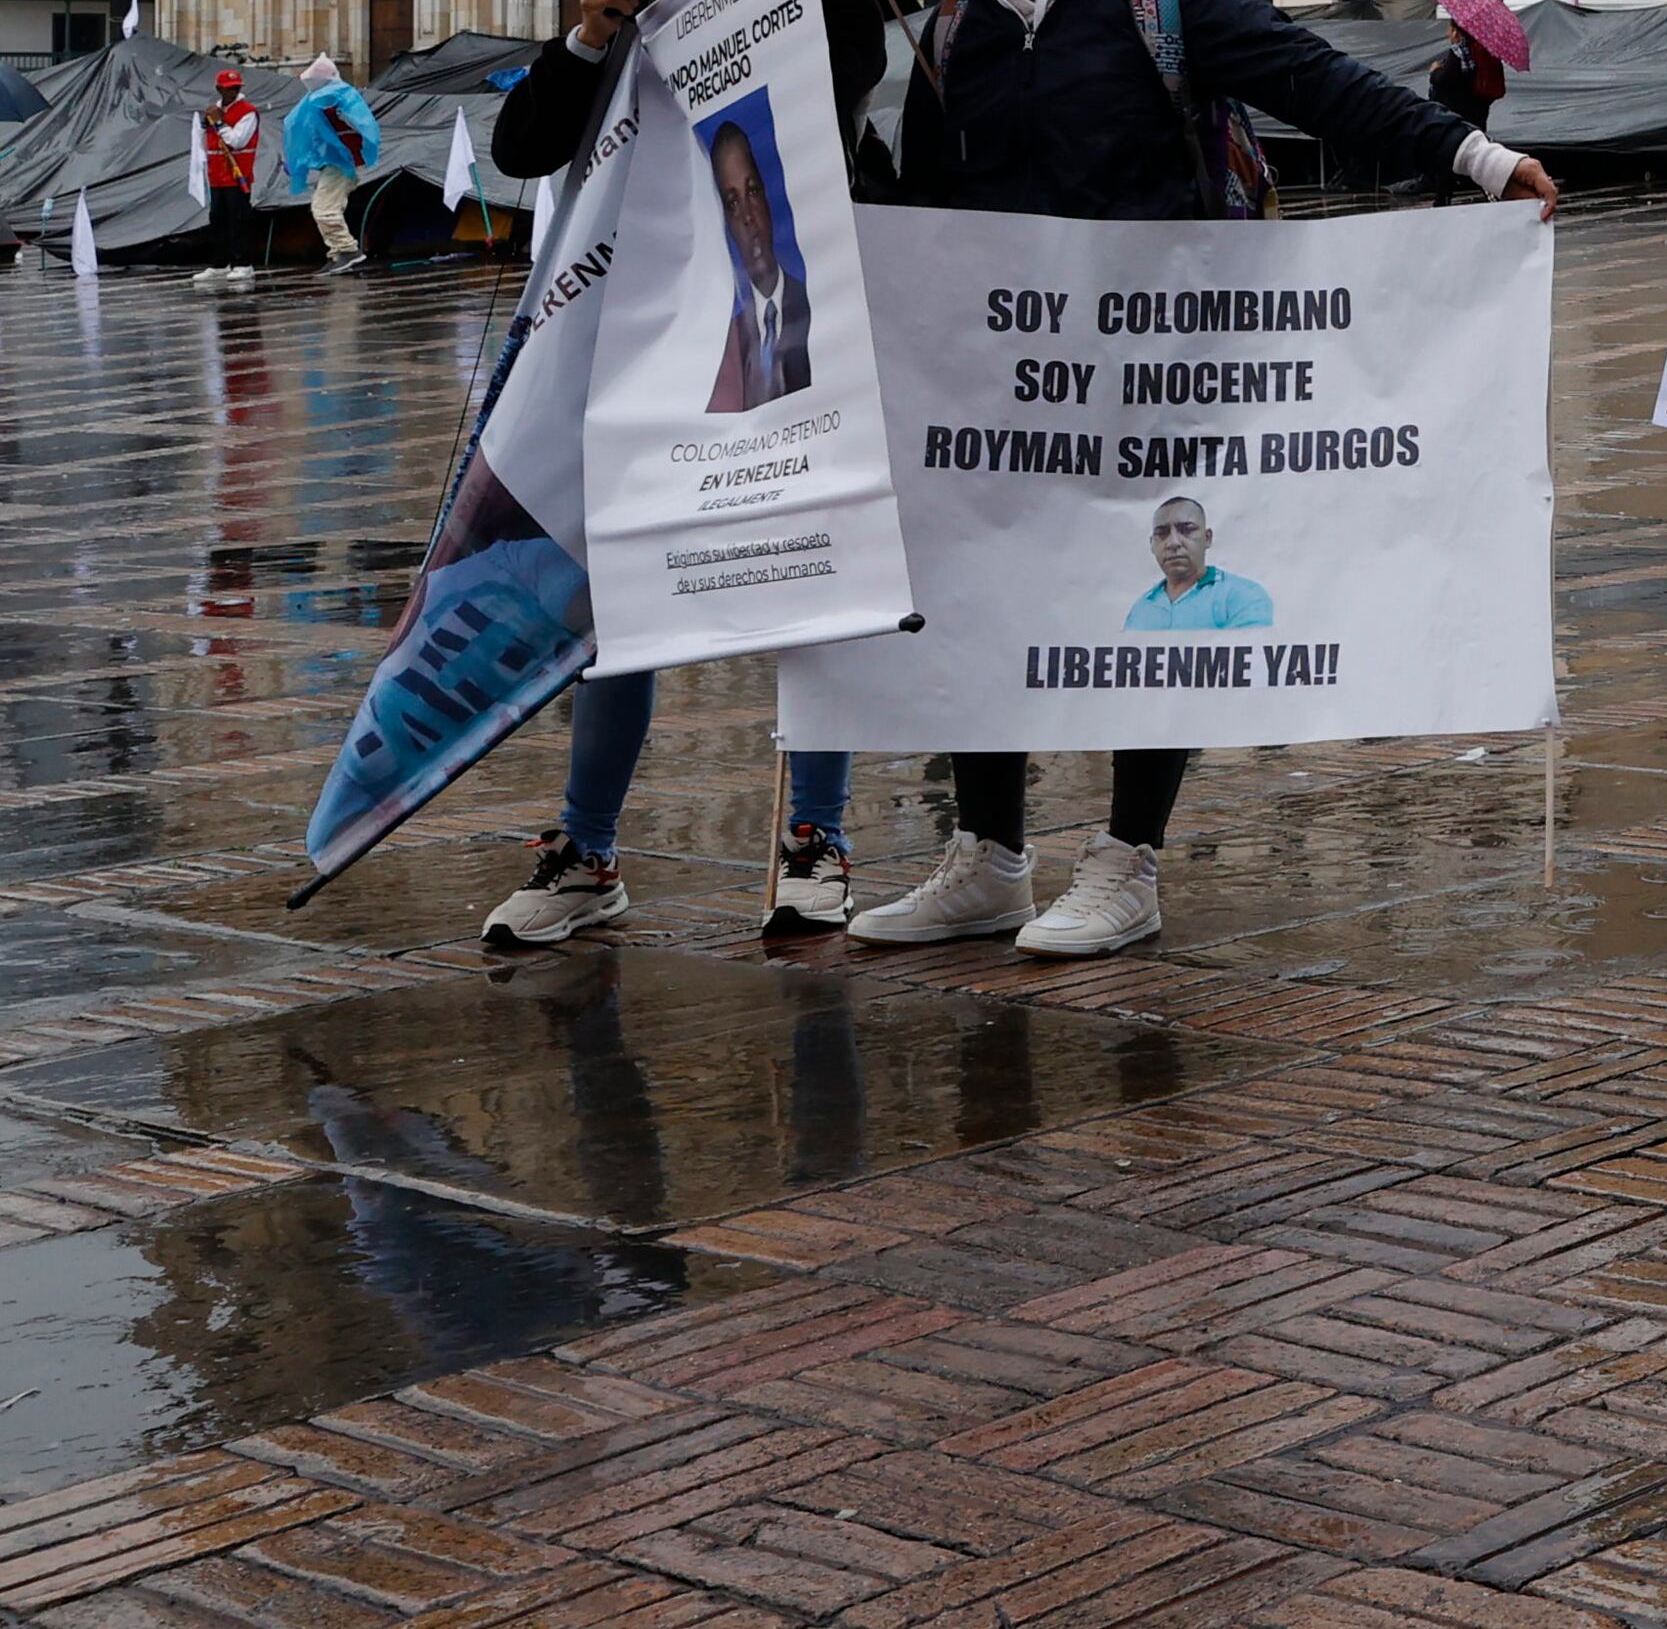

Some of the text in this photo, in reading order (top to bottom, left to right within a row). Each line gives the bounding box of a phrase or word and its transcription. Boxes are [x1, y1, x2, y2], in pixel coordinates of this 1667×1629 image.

[699, 27, 751, 76] MANUEL
[688, 55, 751, 110] PRECIADO
[986, 287, 1351, 336] SOY COLOMBIANO
[1014, 358, 1314, 406] SOY INOCENTE
[671, 410, 841, 462] COLOMBIANO RETENIDO
[924, 424, 1420, 480] ROYMAN SANTA BURGOS
[699, 454, 810, 492] EN VENEZUELA
[698, 489, 785, 512] ILEGALMENTE
[783, 532, 831, 553] respeto
[699, 576, 717, 590] sus
[718, 566, 770, 588] derechos
[771, 559, 833, 581] humanos
[1026, 643, 1340, 690] LIBERENME YA!!
